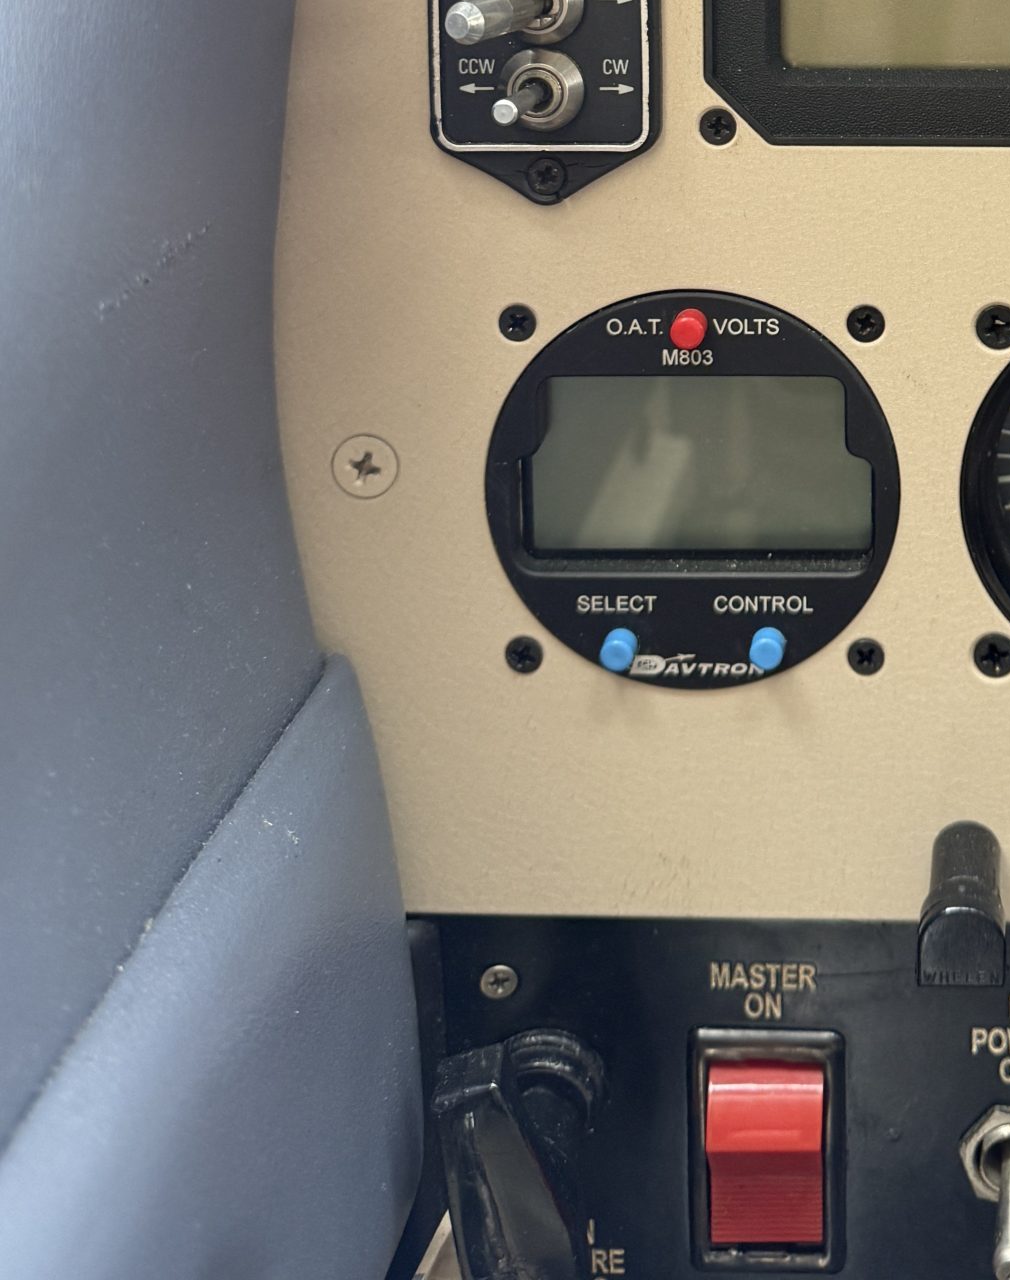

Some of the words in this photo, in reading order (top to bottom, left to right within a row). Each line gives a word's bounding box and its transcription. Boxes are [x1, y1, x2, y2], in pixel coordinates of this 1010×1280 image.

[458, 58, 496, 75] CCW
[602, 58, 629, 75] CW
[606, 318, 664, 336] O.A.T.
[712, 318, 780, 336] VOLTS
[662, 348, 714, 366] M803
[577, 596, 657, 613] SELECT
[713, 596, 814, 614] CONTROL
[710, 962, 817, 993] MASTER
[744, 992, 782, 1019] ON
